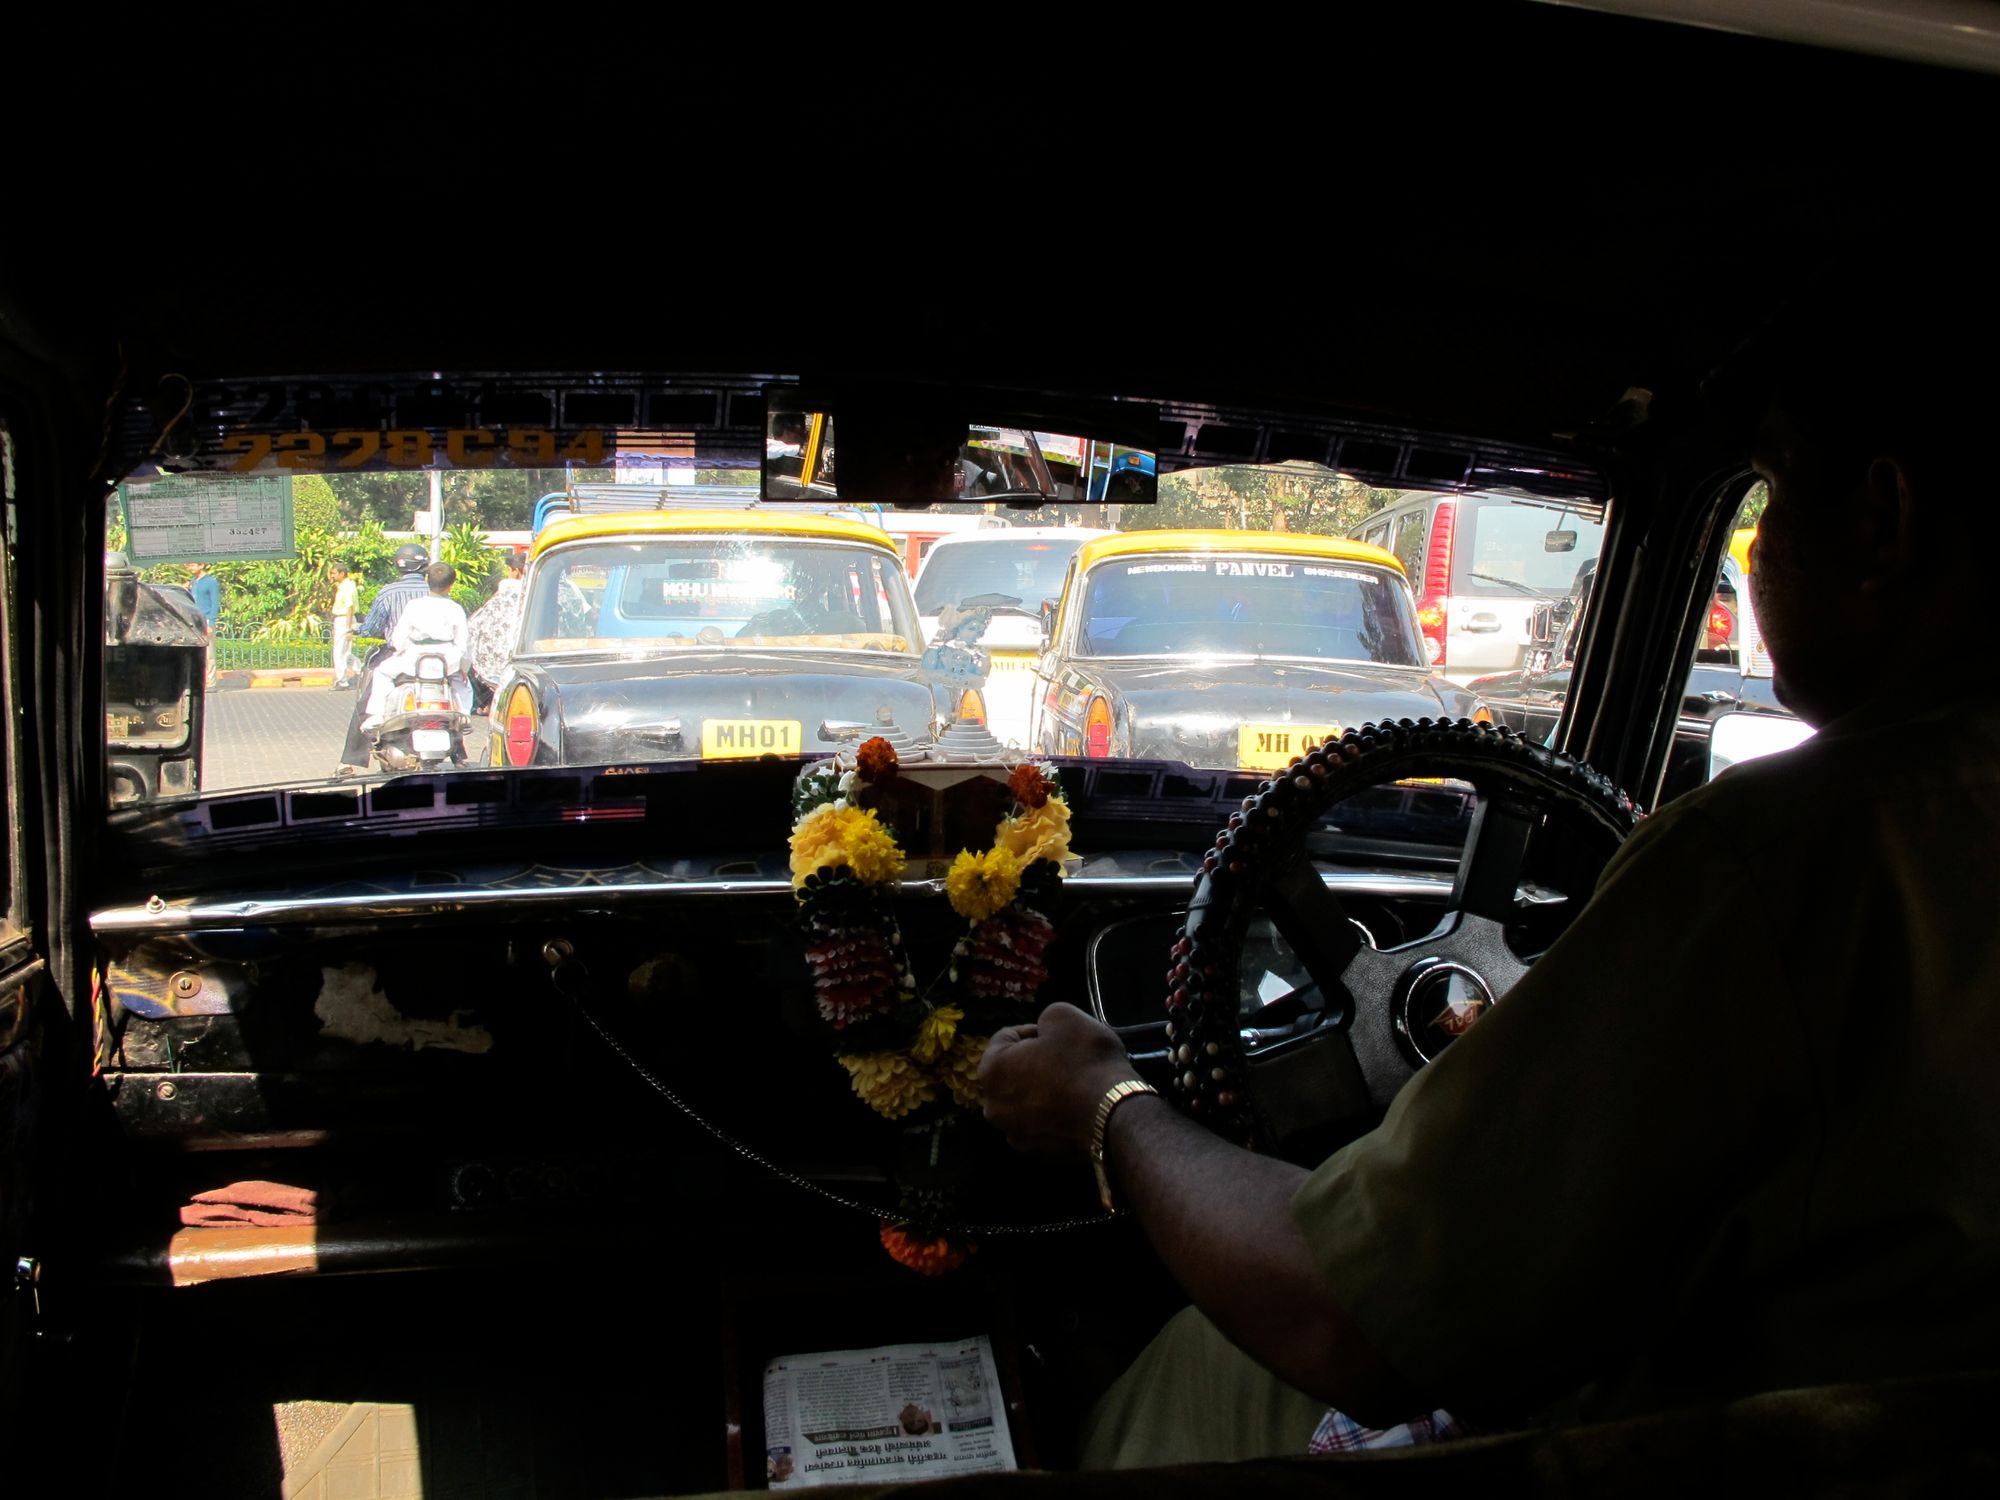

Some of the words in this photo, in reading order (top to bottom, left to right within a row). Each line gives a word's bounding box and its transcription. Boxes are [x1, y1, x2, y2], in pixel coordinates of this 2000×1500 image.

[1215, 562, 1294, 578] PANVEL
[716, 725, 790, 748] MH01
[1256, 733, 1291, 753] MH
